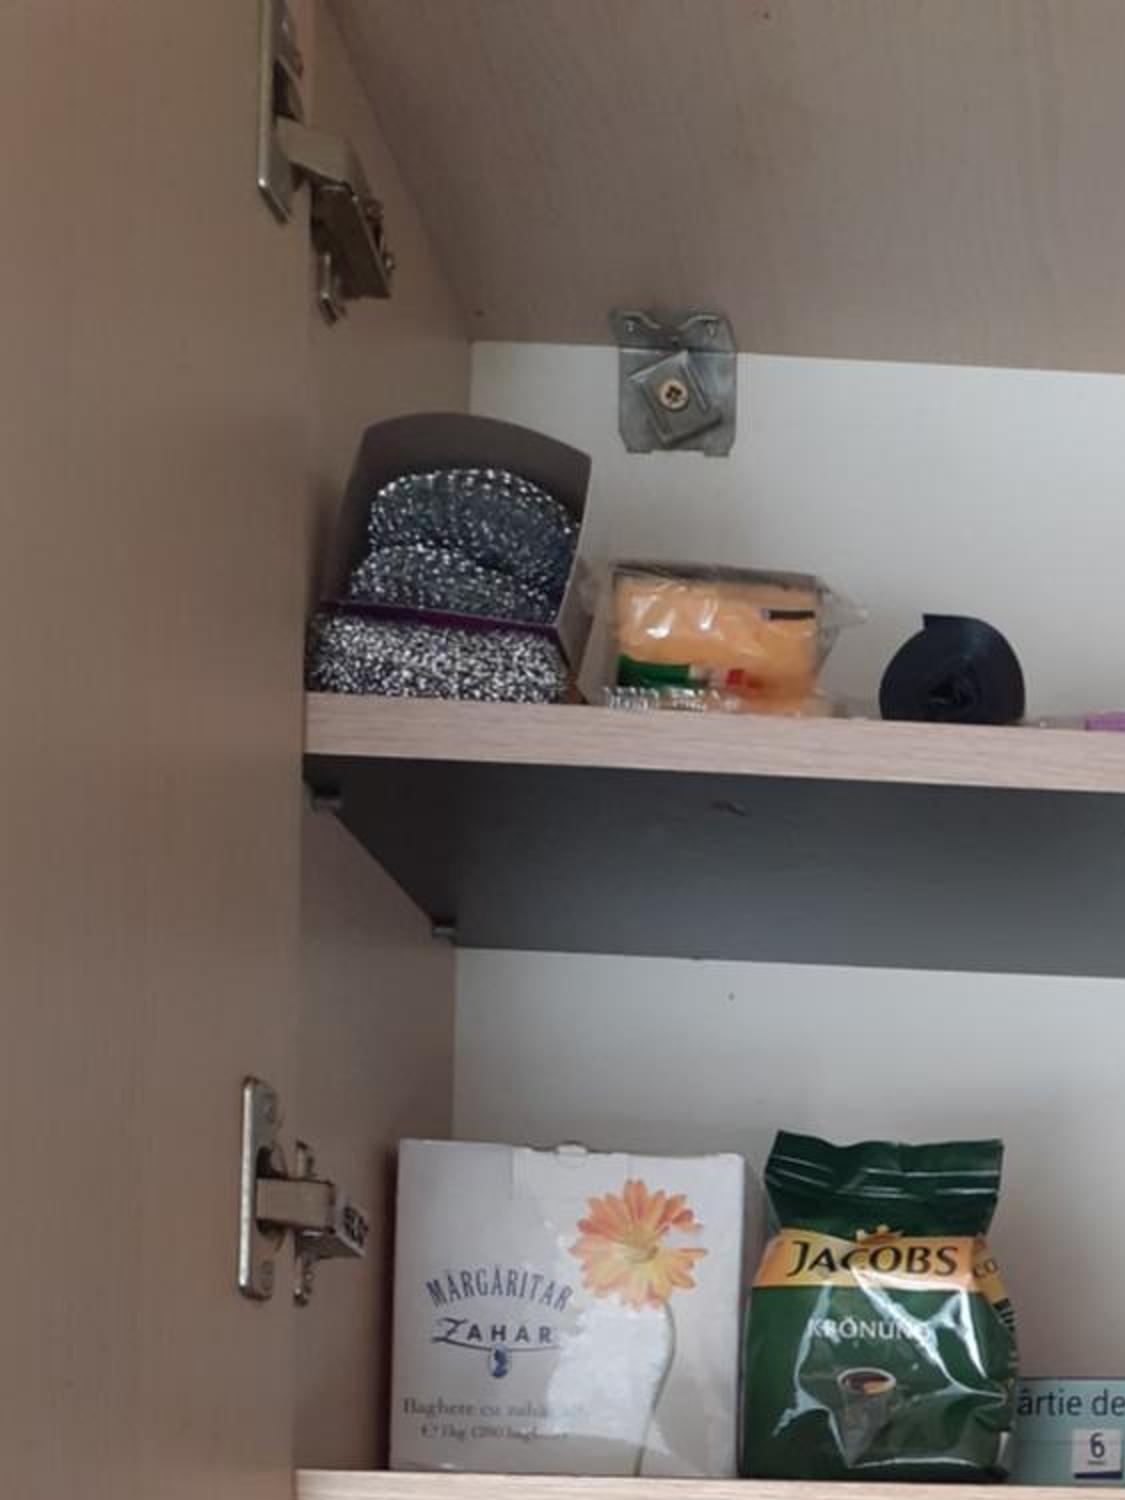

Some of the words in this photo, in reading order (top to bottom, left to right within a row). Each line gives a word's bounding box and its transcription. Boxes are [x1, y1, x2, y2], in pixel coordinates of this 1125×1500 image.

[787, 1240, 959, 1277] JACOBS
[1017, 1388, 1082, 1417] ârtie
[1089, 1432, 1106, 1459] 6
